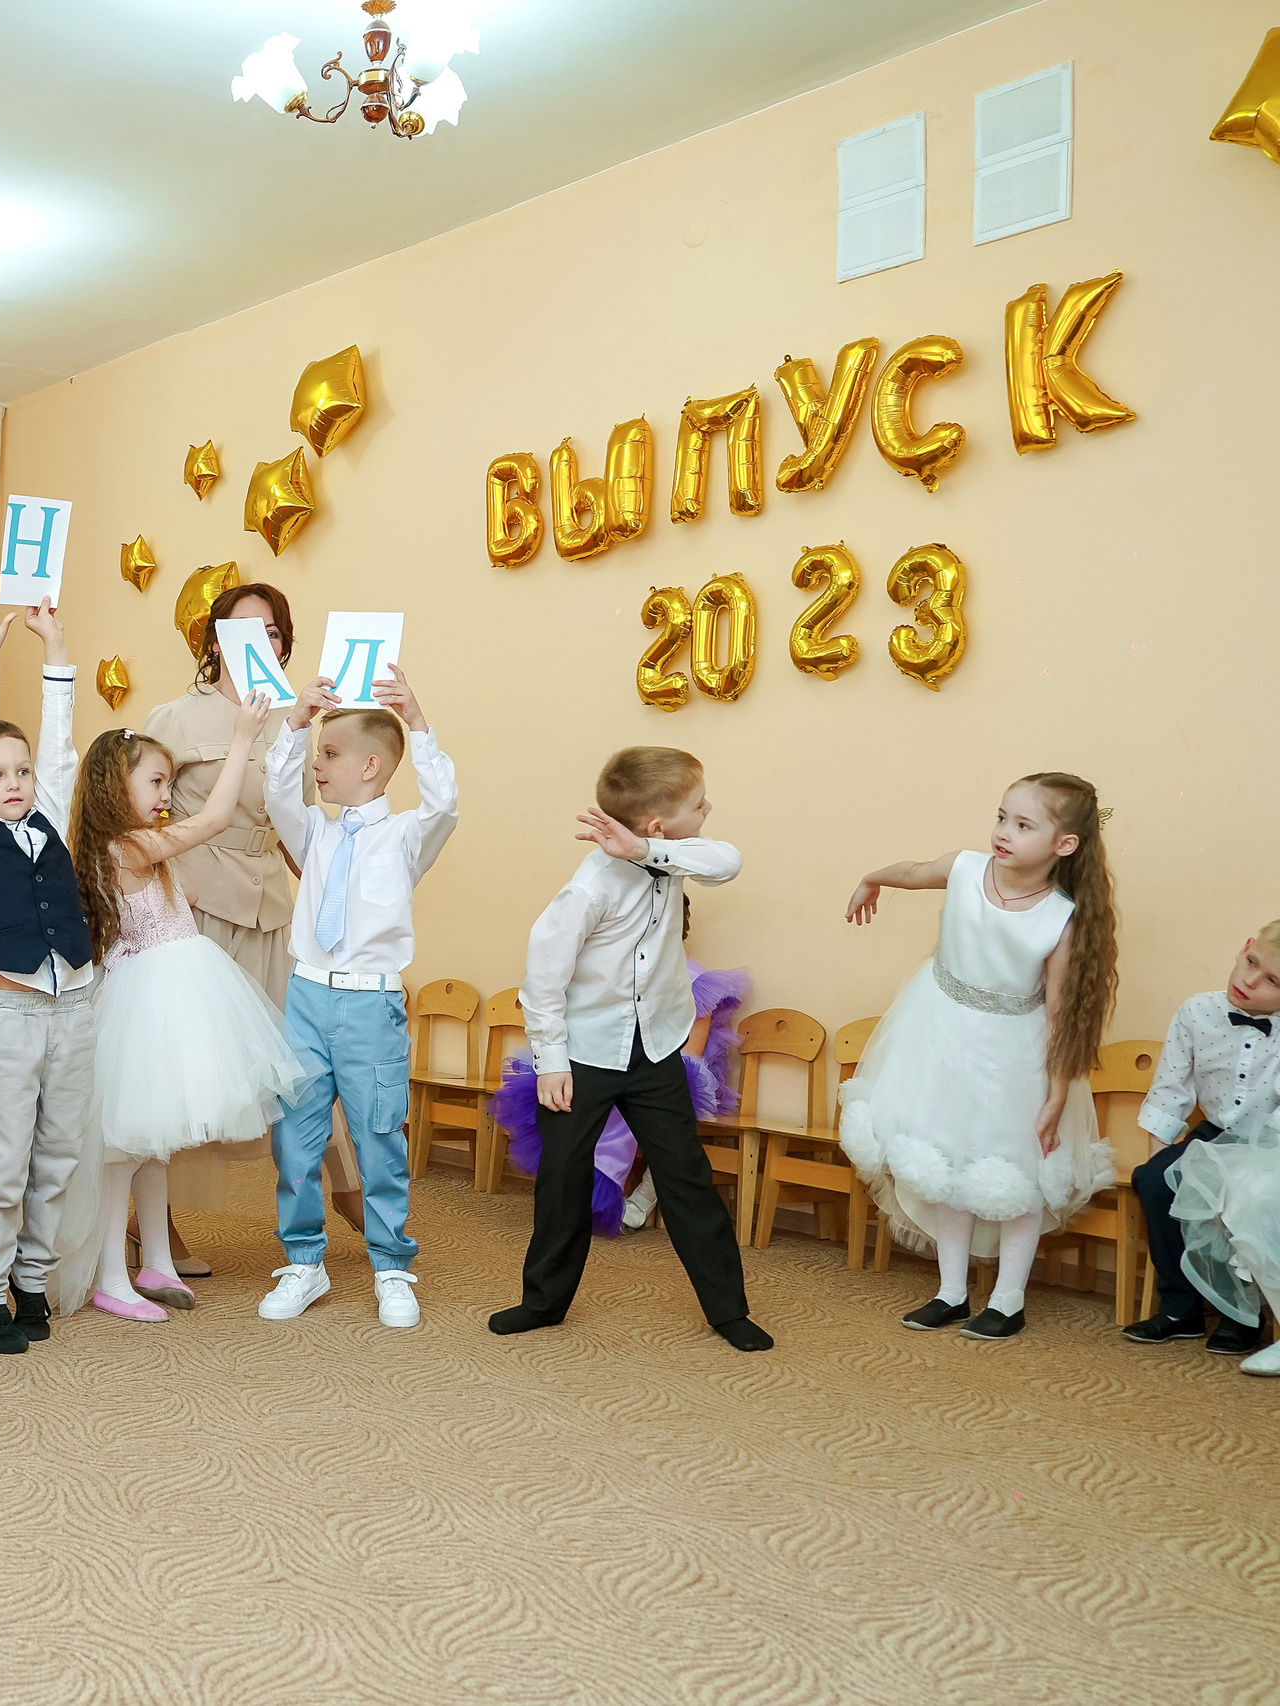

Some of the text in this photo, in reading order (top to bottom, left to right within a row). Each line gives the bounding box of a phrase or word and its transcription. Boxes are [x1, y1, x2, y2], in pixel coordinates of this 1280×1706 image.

[486, 269, 1138, 568] ВЫПУСК
[2, 503, 60, 578] Н
[636, 539, 968, 712] 2023
[245, 643, 296, 704] А
[329, 638, 386, 702] Л
